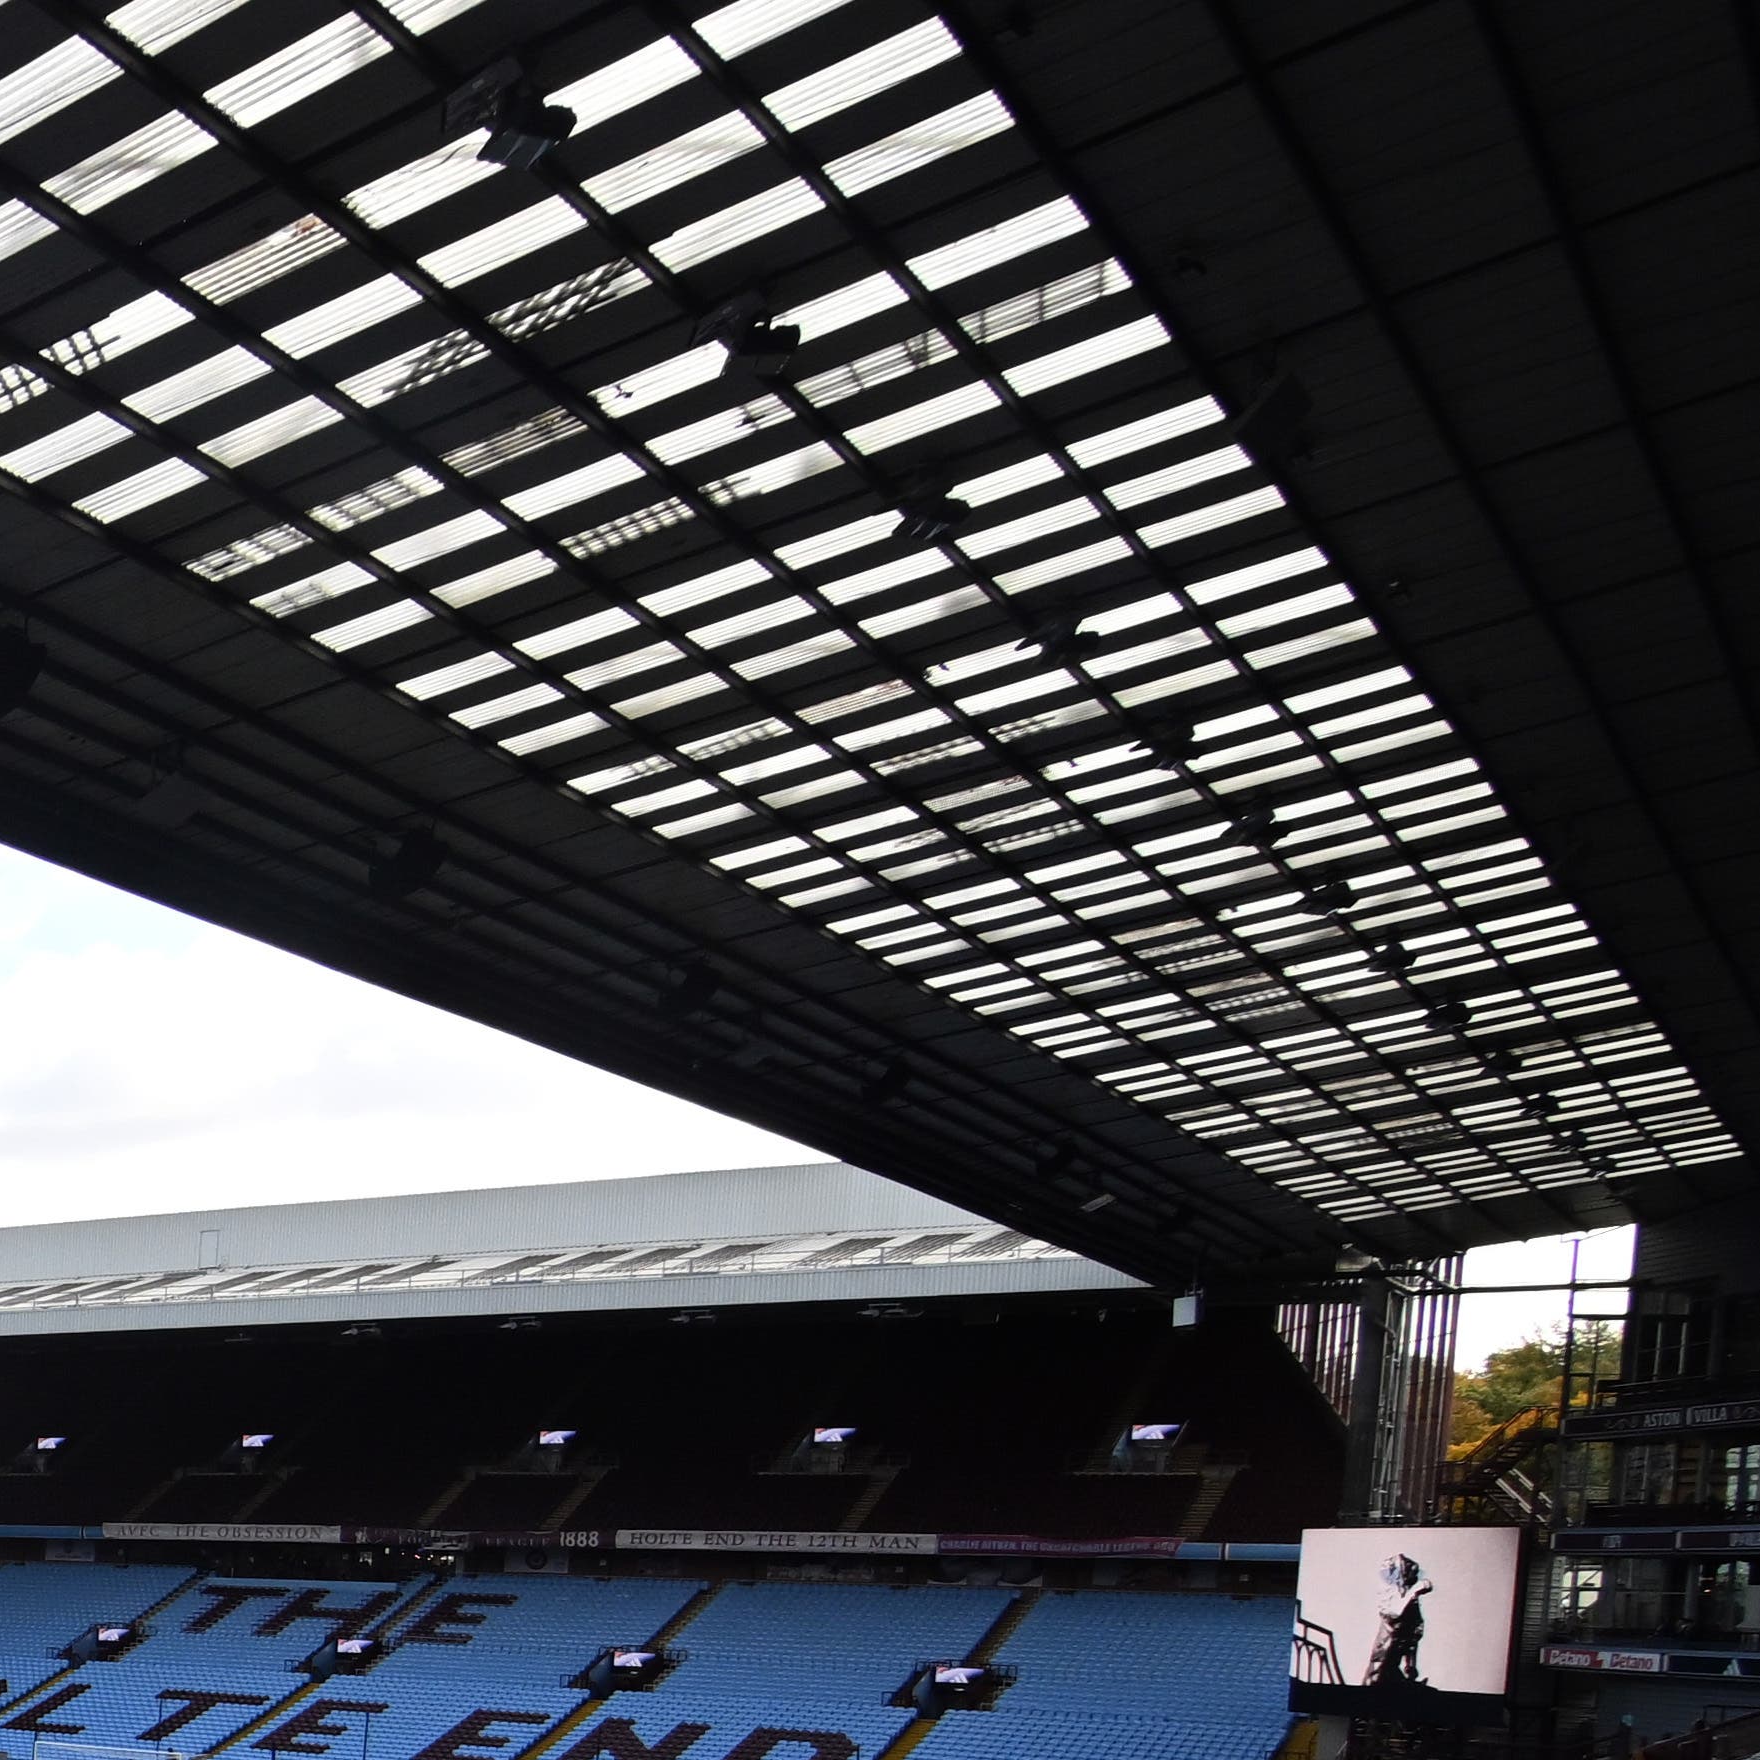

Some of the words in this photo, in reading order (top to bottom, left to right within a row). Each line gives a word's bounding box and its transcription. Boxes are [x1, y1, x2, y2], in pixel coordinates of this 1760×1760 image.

[1644, 1412, 1679, 1427] ASTON
[1694, 1406, 1727, 1423] VILLA
[117, 1525, 160, 1537] AVFC
[173, 1526, 212, 1538] THE
[217, 1526, 322, 1540] OBSESSION
[559, 1531, 599, 1548] 1888
[630, 1533, 693, 1546] HOLTE
[704, 1534, 745, 1546] END
[755, 1534, 797, 1547] THE
[808, 1535, 857, 1548] 12TH
[869, 1536, 920, 1549] MAN
[184, 1583, 517, 1645] THE
[1550, 1650, 1590, 1667] Betano
[1610, 1653, 1654, 1670] Betano
